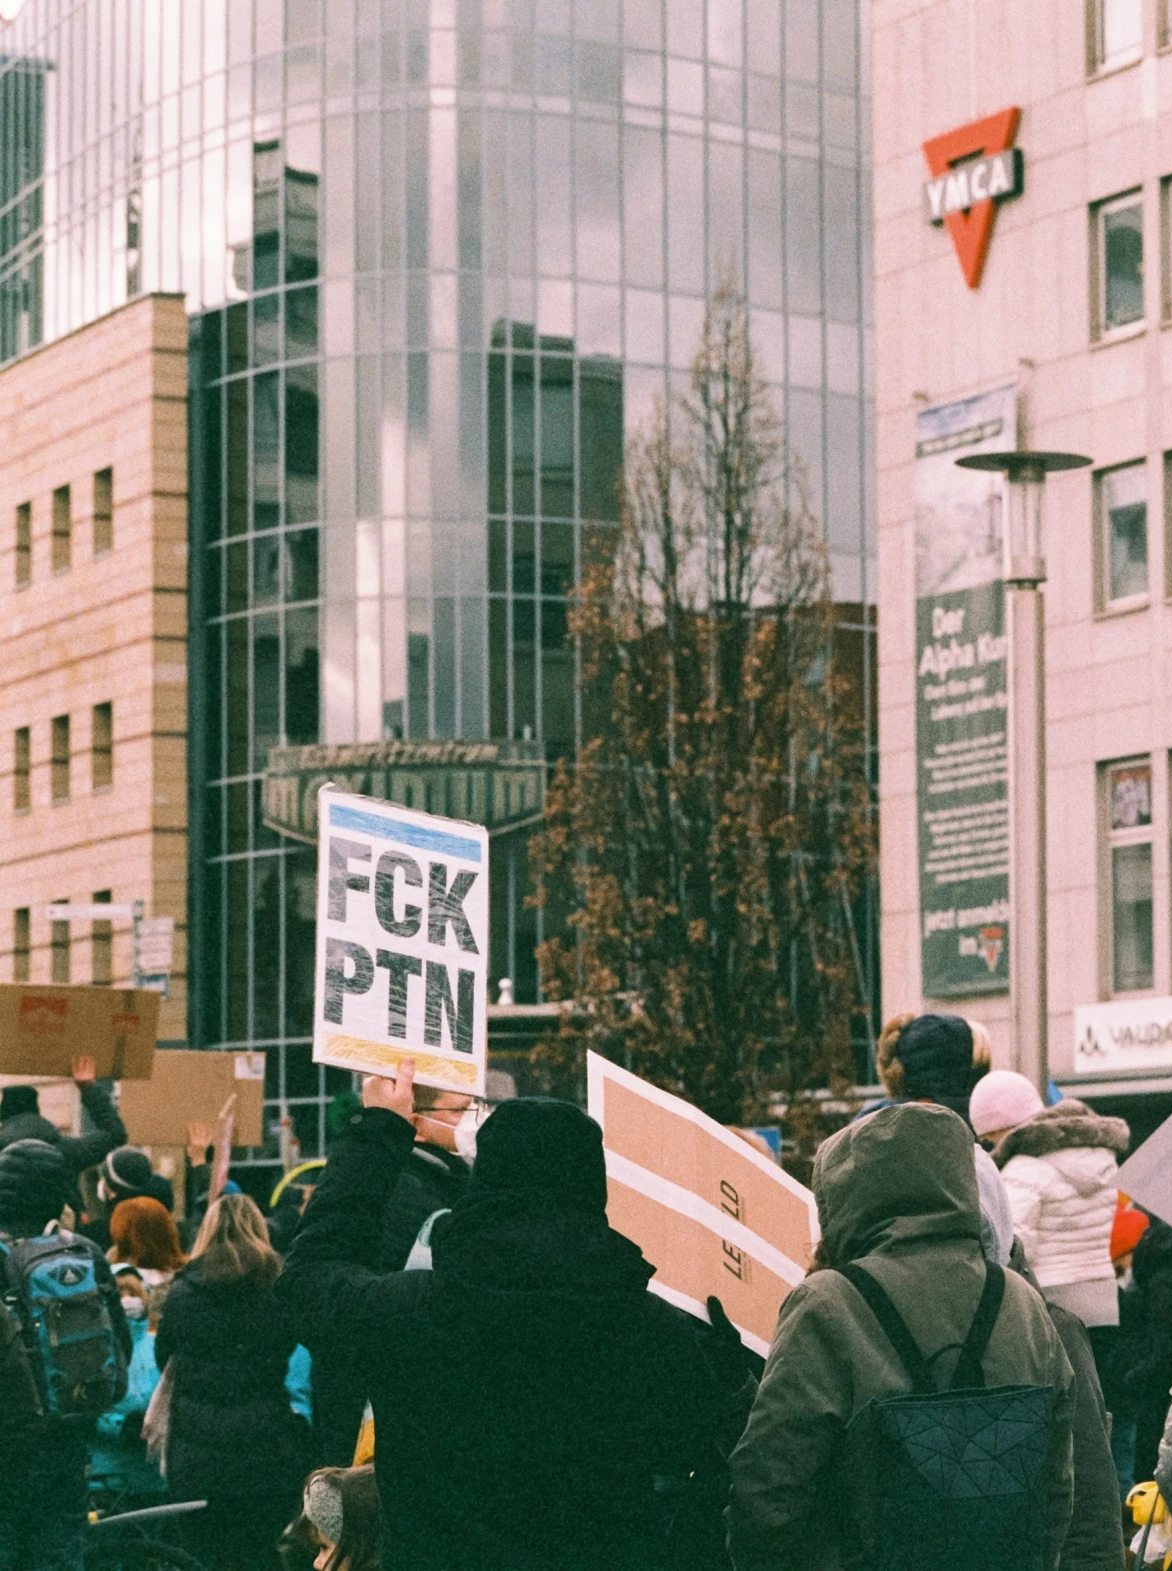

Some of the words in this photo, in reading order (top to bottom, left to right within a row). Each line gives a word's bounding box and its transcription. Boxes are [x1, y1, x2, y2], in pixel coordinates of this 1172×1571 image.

[926, 156, 1010, 216] YMCA
[326, 835, 481, 955] FCK
[322, 936, 475, 1055] PTN
[719, 1179, 742, 1281] LELD
